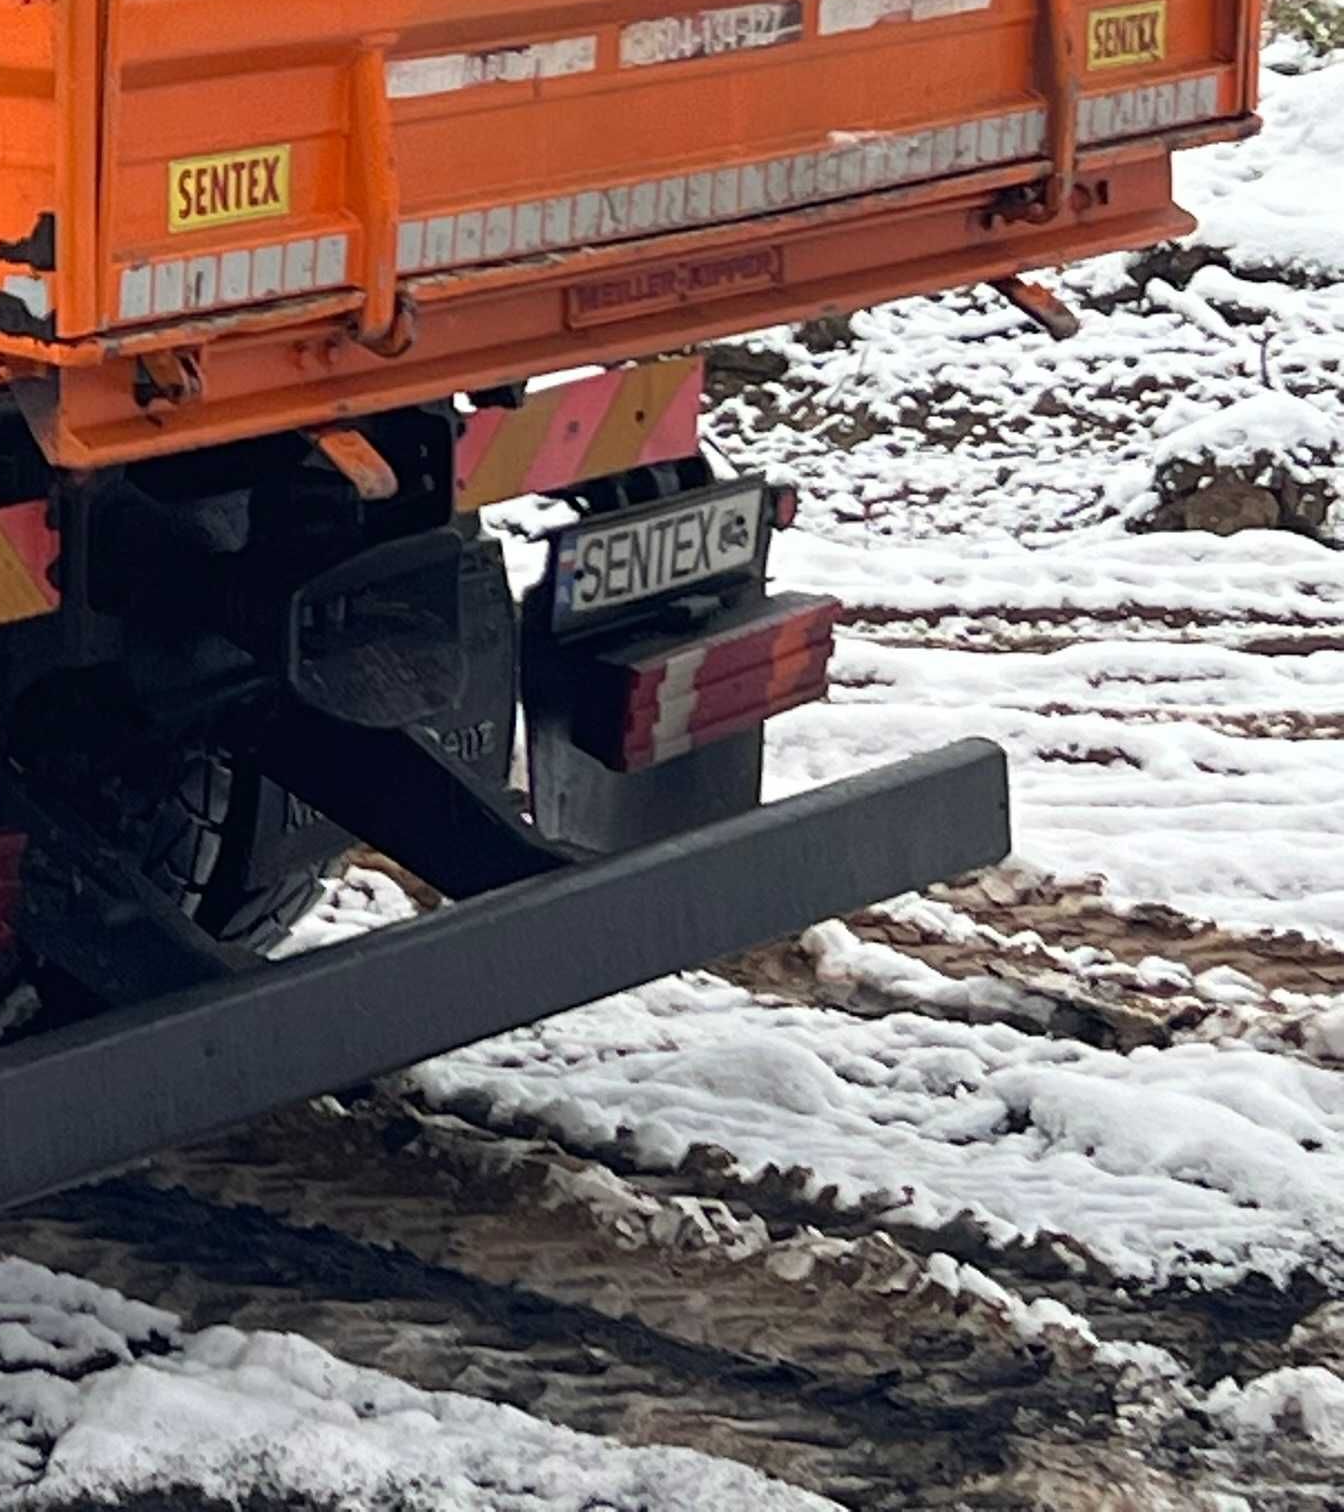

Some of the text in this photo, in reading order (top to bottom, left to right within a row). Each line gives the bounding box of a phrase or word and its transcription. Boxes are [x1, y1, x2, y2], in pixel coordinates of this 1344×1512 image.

[1094, 11, 1159, 61] SENTEX
[178, 155, 281, 220] SENTEX
[581, 505, 718, 602] SENTEX
